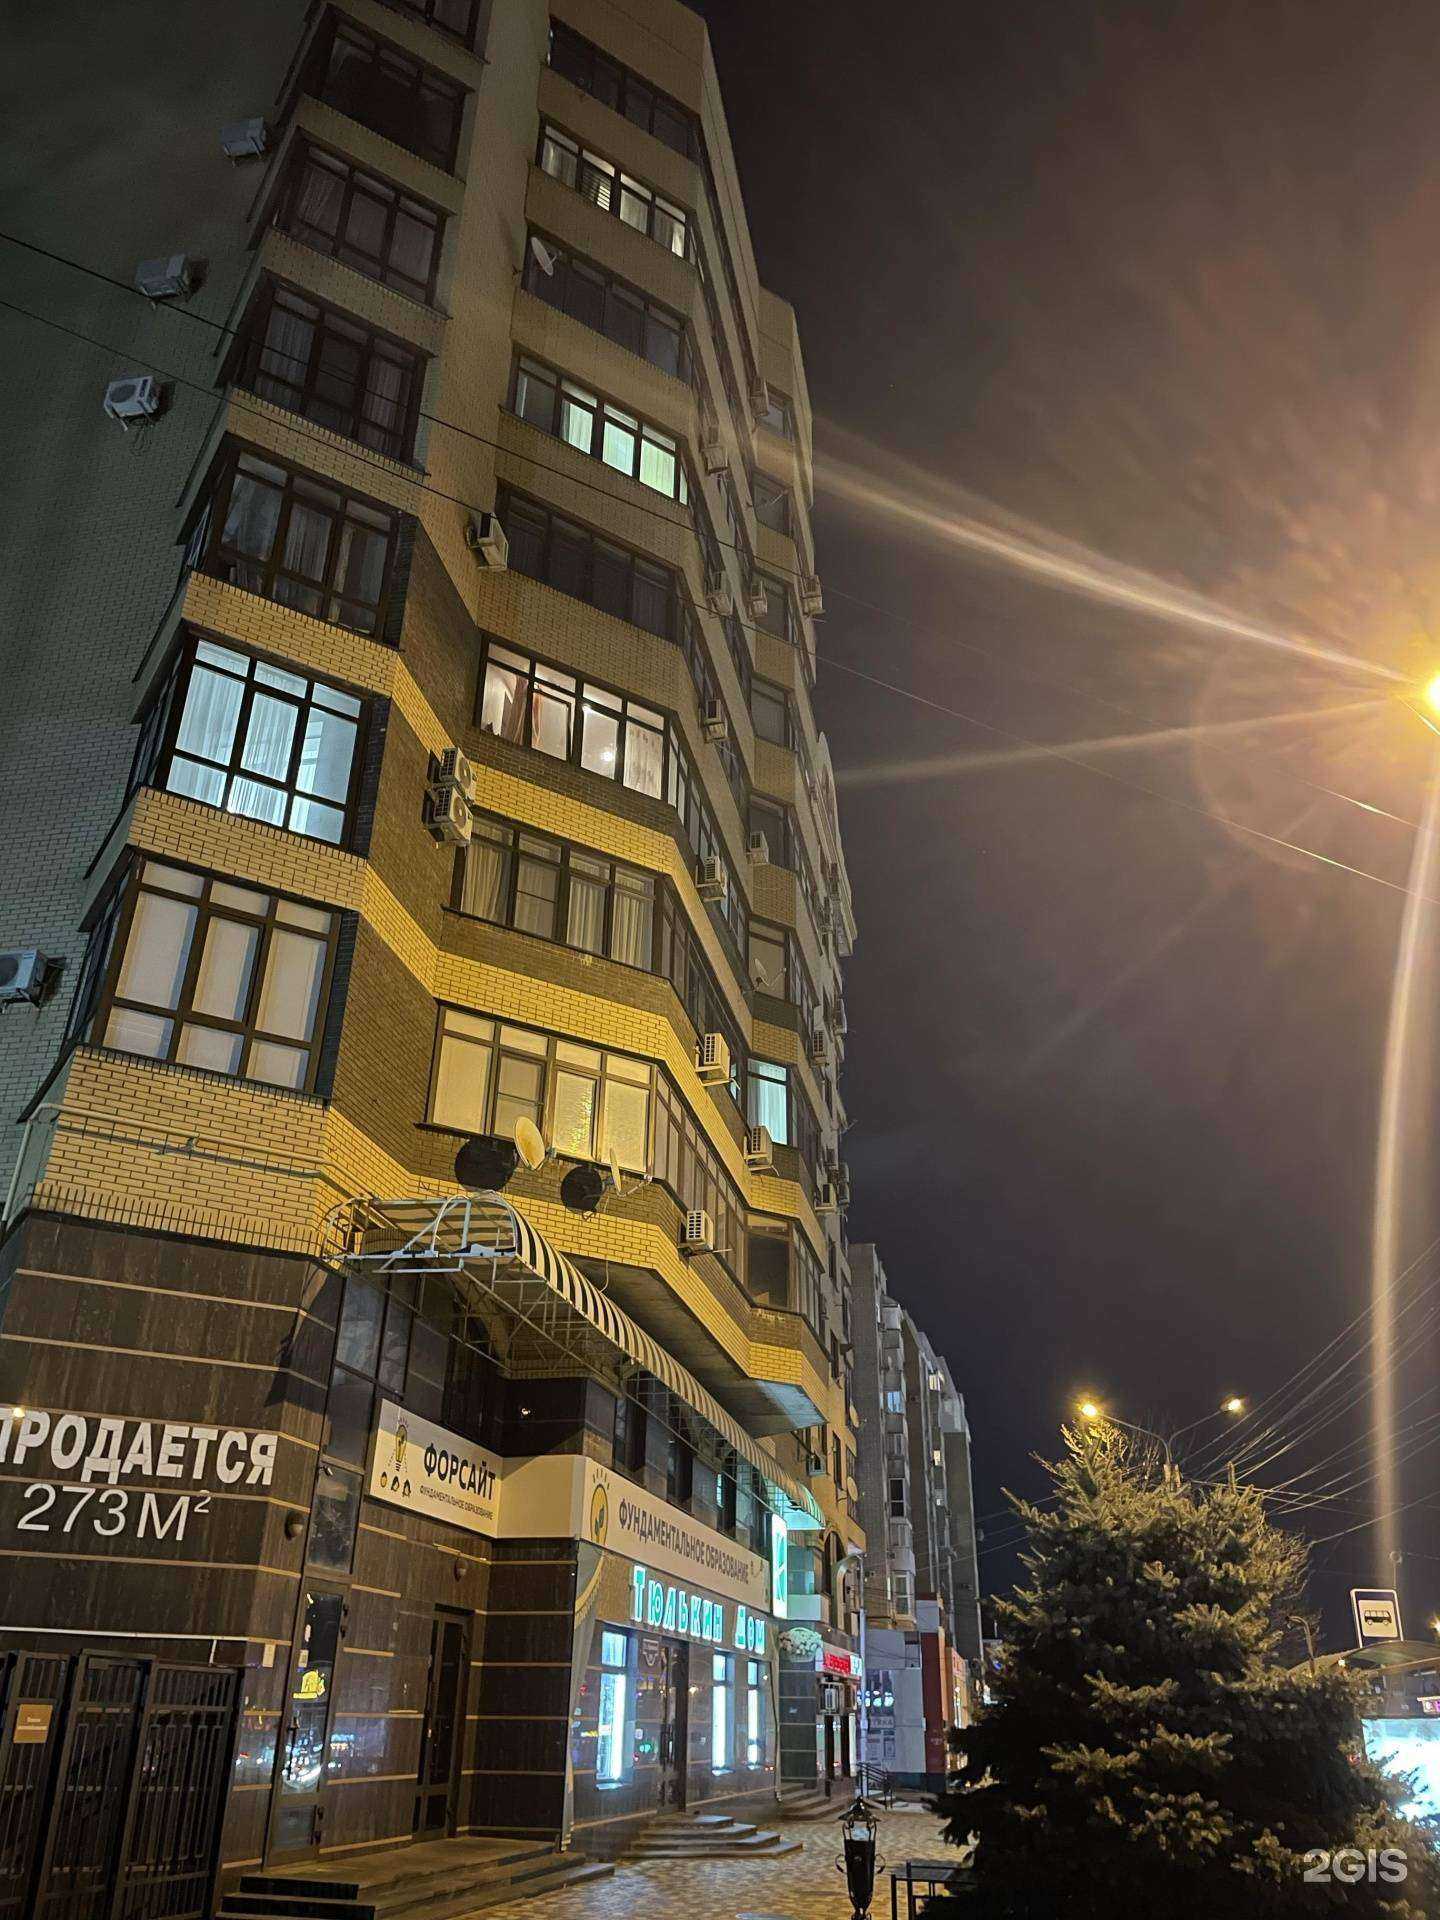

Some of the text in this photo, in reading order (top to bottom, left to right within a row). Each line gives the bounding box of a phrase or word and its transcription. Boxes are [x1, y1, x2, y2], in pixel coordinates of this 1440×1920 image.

[423, 1442, 496, 1501] ФОРСАЙТ
[618, 1497, 750, 1585] ФУНДАМЕНТАЛЬНОЕ ОБРАЗОВАНИЕ
